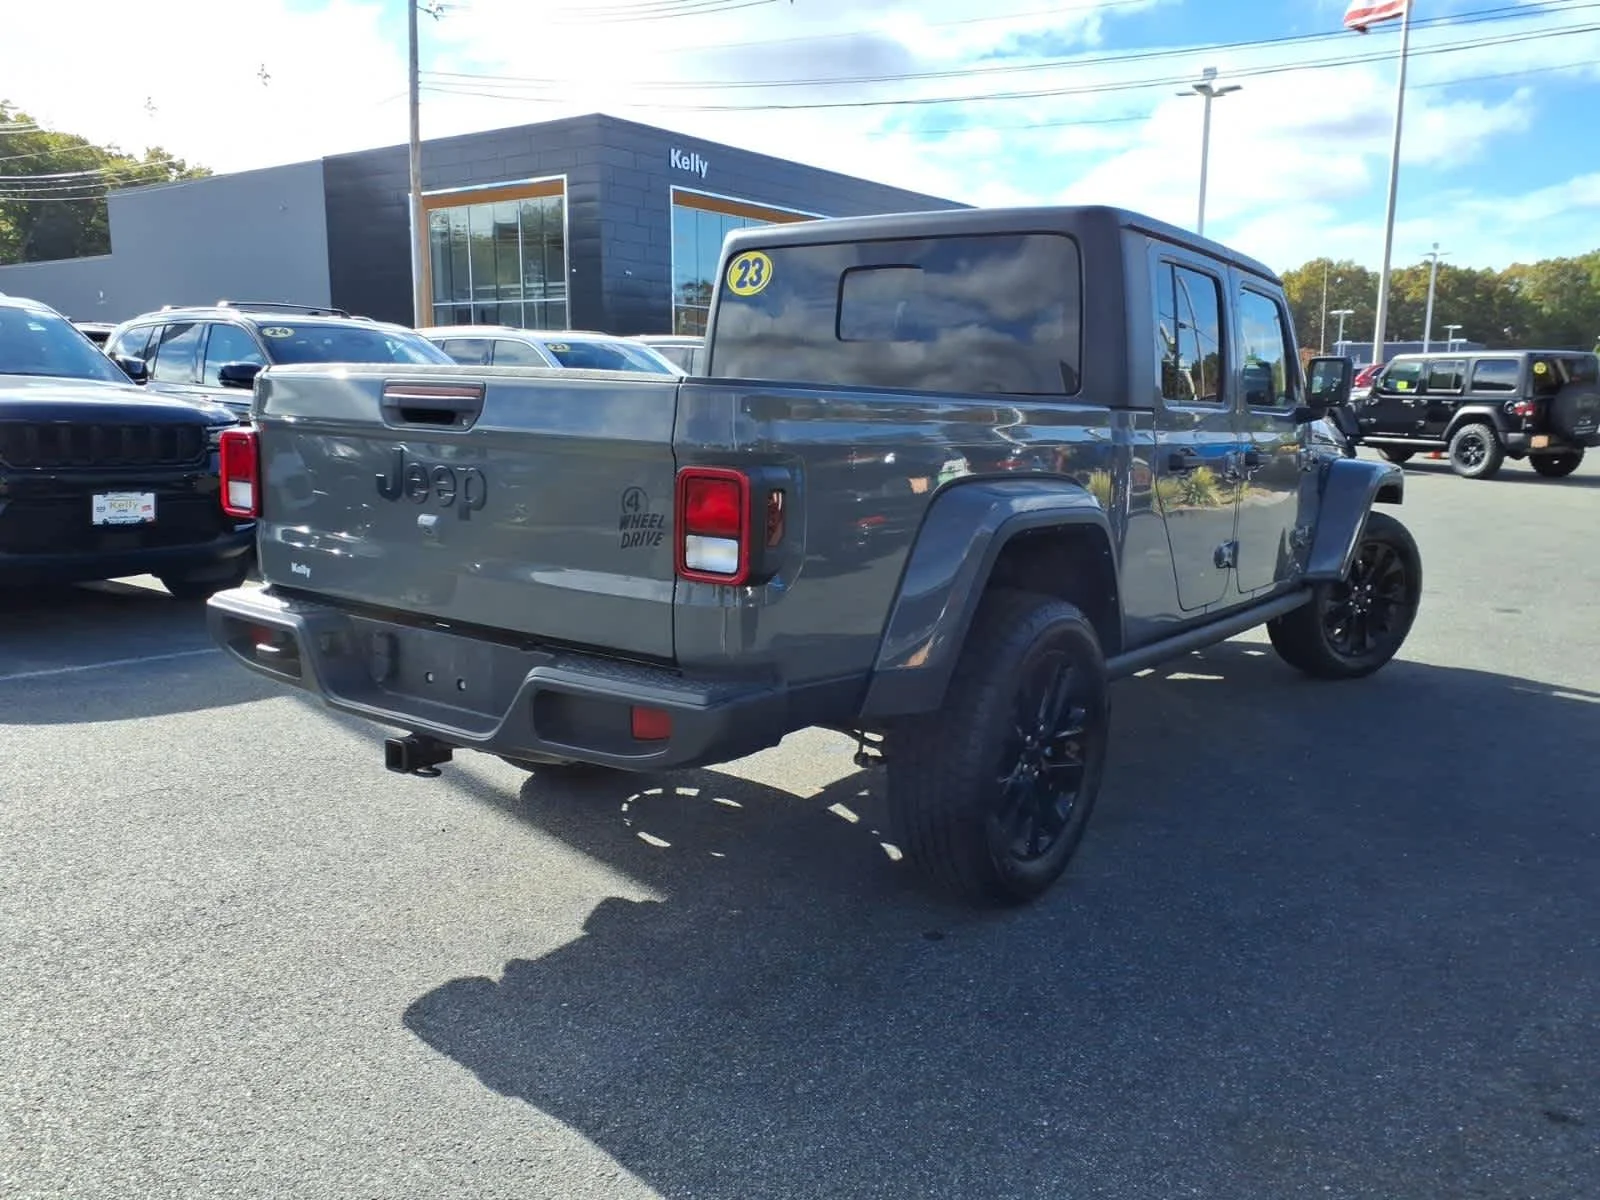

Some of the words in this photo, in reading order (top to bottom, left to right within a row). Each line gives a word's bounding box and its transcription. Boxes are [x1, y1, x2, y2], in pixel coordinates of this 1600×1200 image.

[670, 148, 708, 178] Kelly
[735, 257, 764, 289] 23
[376, 442, 487, 521] Jeep
[619, 512, 665, 531] WHEEL
[621, 531, 665, 549] DRIVE
